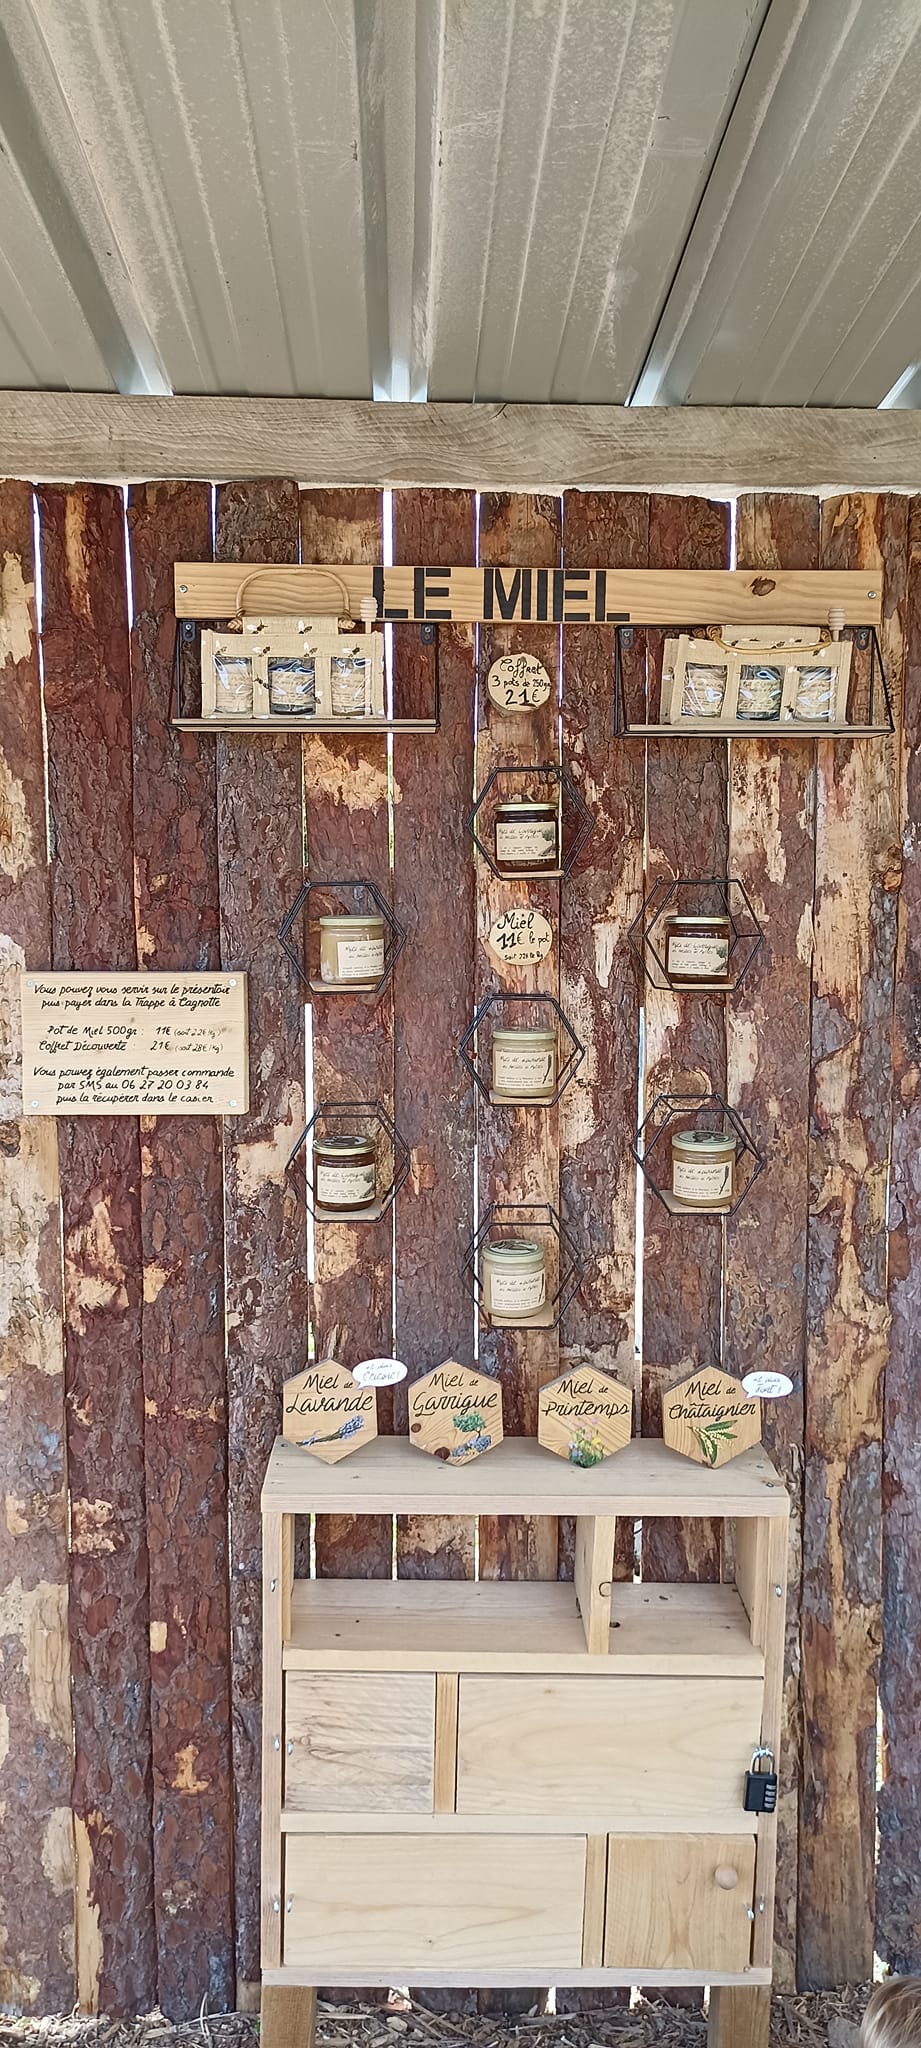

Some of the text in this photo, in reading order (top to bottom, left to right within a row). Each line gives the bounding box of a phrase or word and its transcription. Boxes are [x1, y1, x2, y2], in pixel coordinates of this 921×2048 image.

[372, 566, 630, 622] LE MIEL
[499, 656, 544, 679] Coffret
[491, 674, 501, 687] 3
[503, 677, 520, 689] pots
[522, 678, 531, 687] de
[505, 688, 541, 706] 21€
[496, 912, 535, 930] Miel
[496, 930, 550, 950] 11€ le pot
[34, 983, 230, 998] Vous pouvez vous servir sur le présentoir
[64, 999, 92, 1012] payer
[94, 997, 118, 1007] dans
[121, 996, 132, 1007] la
[135, 996, 166, 1009] Trappe
[168, 996, 177, 1007] à
[178, 996, 221, 1012] Cagnotte
[47, 1025, 69, 1035] Pot
[67, 1025, 78, 1035] de
[82, 1025, 104, 1038] Miel
[155, 1026, 171, 1036] 11€
[38, 1040, 73, 1054] Coffret
[73, 1040, 128, 1051] Découverte
[150, 1040, 171, 1051] 21€
[33, 1065, 235, 1080] Vous pouvez également passer commande
[57, 1082, 76, 1091] par
[79, 1079, 102, 1091] SMS
[121, 1079, 136, 1090] 06
[139, 1079, 155, 1090] 27
[157, 1079, 173, 1090] 20
[176, 1079, 192, 1090] 03
[195, 1079, 209, 1090] 84
[55, 1092, 214, 1105] puis la récupérer dans le casier
[302, 1372, 354, 1395] Miel de
[428, 1372, 480, 1393] Miel de
[556, 1378, 609, 1398] Miel de
[684, 1380, 737, 1401] Miel de
[285, 1391, 374, 1416] Lavande
[412, 1391, 499, 1418] Garrigue
[541, 1400, 630, 1420] Printemps
[667, 1401, 758, 1422] Châtaignier
